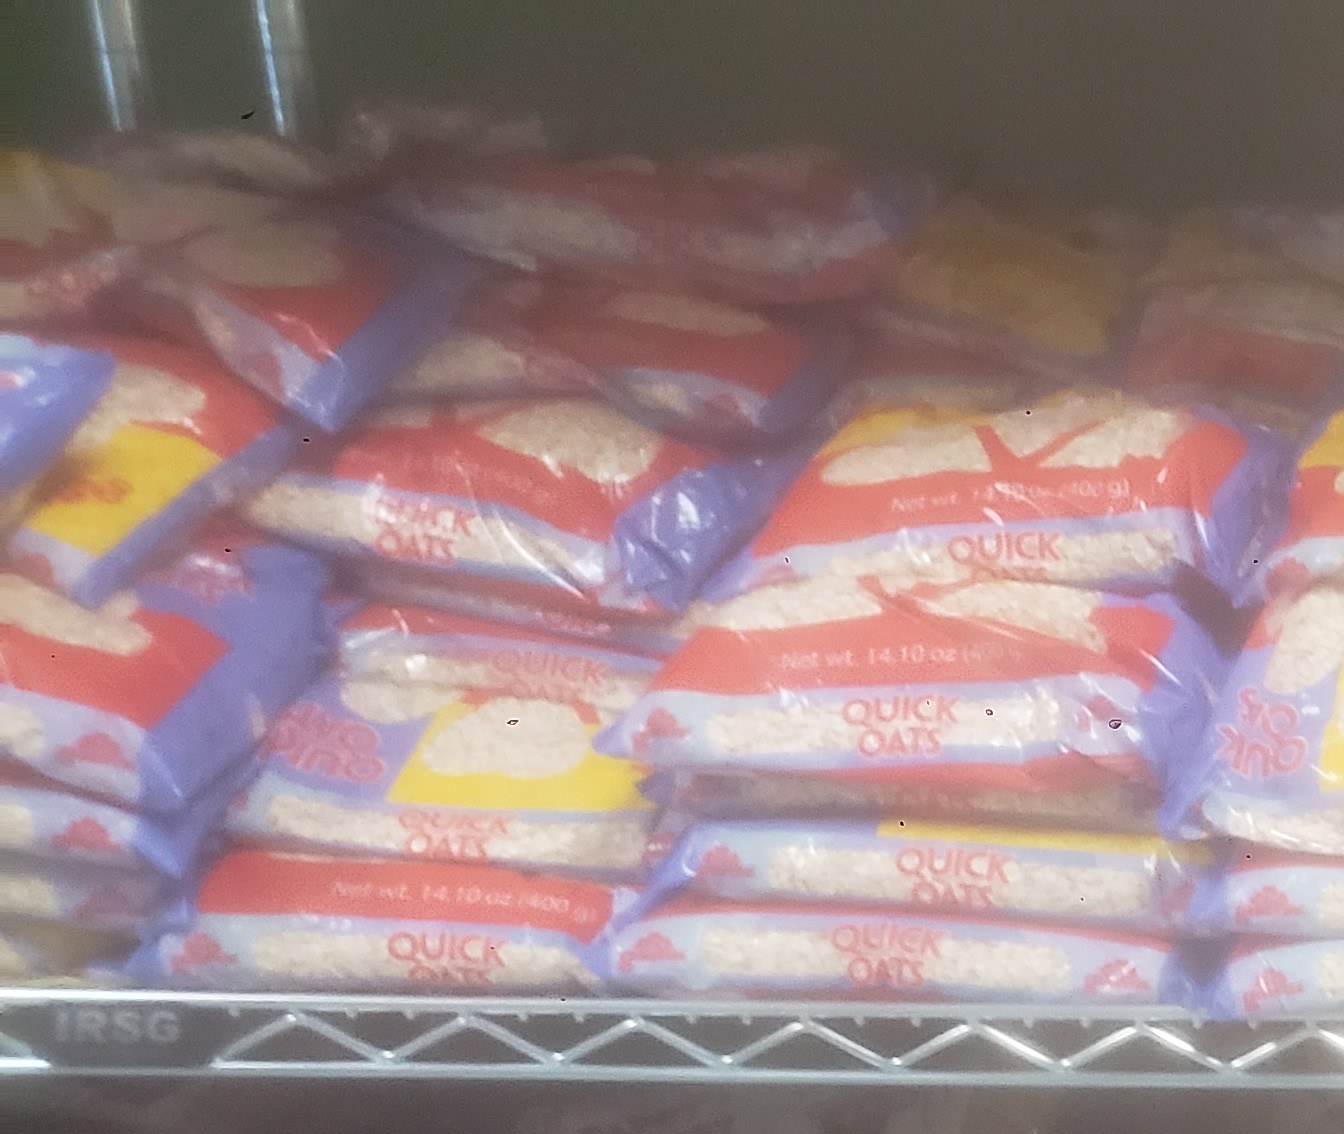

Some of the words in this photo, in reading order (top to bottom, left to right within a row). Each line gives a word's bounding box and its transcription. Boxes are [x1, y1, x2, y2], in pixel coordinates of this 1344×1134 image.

[948, 532, 1060, 566] QUICK
[843, 695, 957, 731] QUICK
[857, 726, 942, 757] OATS
[895, 846, 1010, 883] QUICK
[387, 931, 506, 968] QUICK
[831, 924, 942, 958] QUICK
[846, 956, 925, 987] OATS
